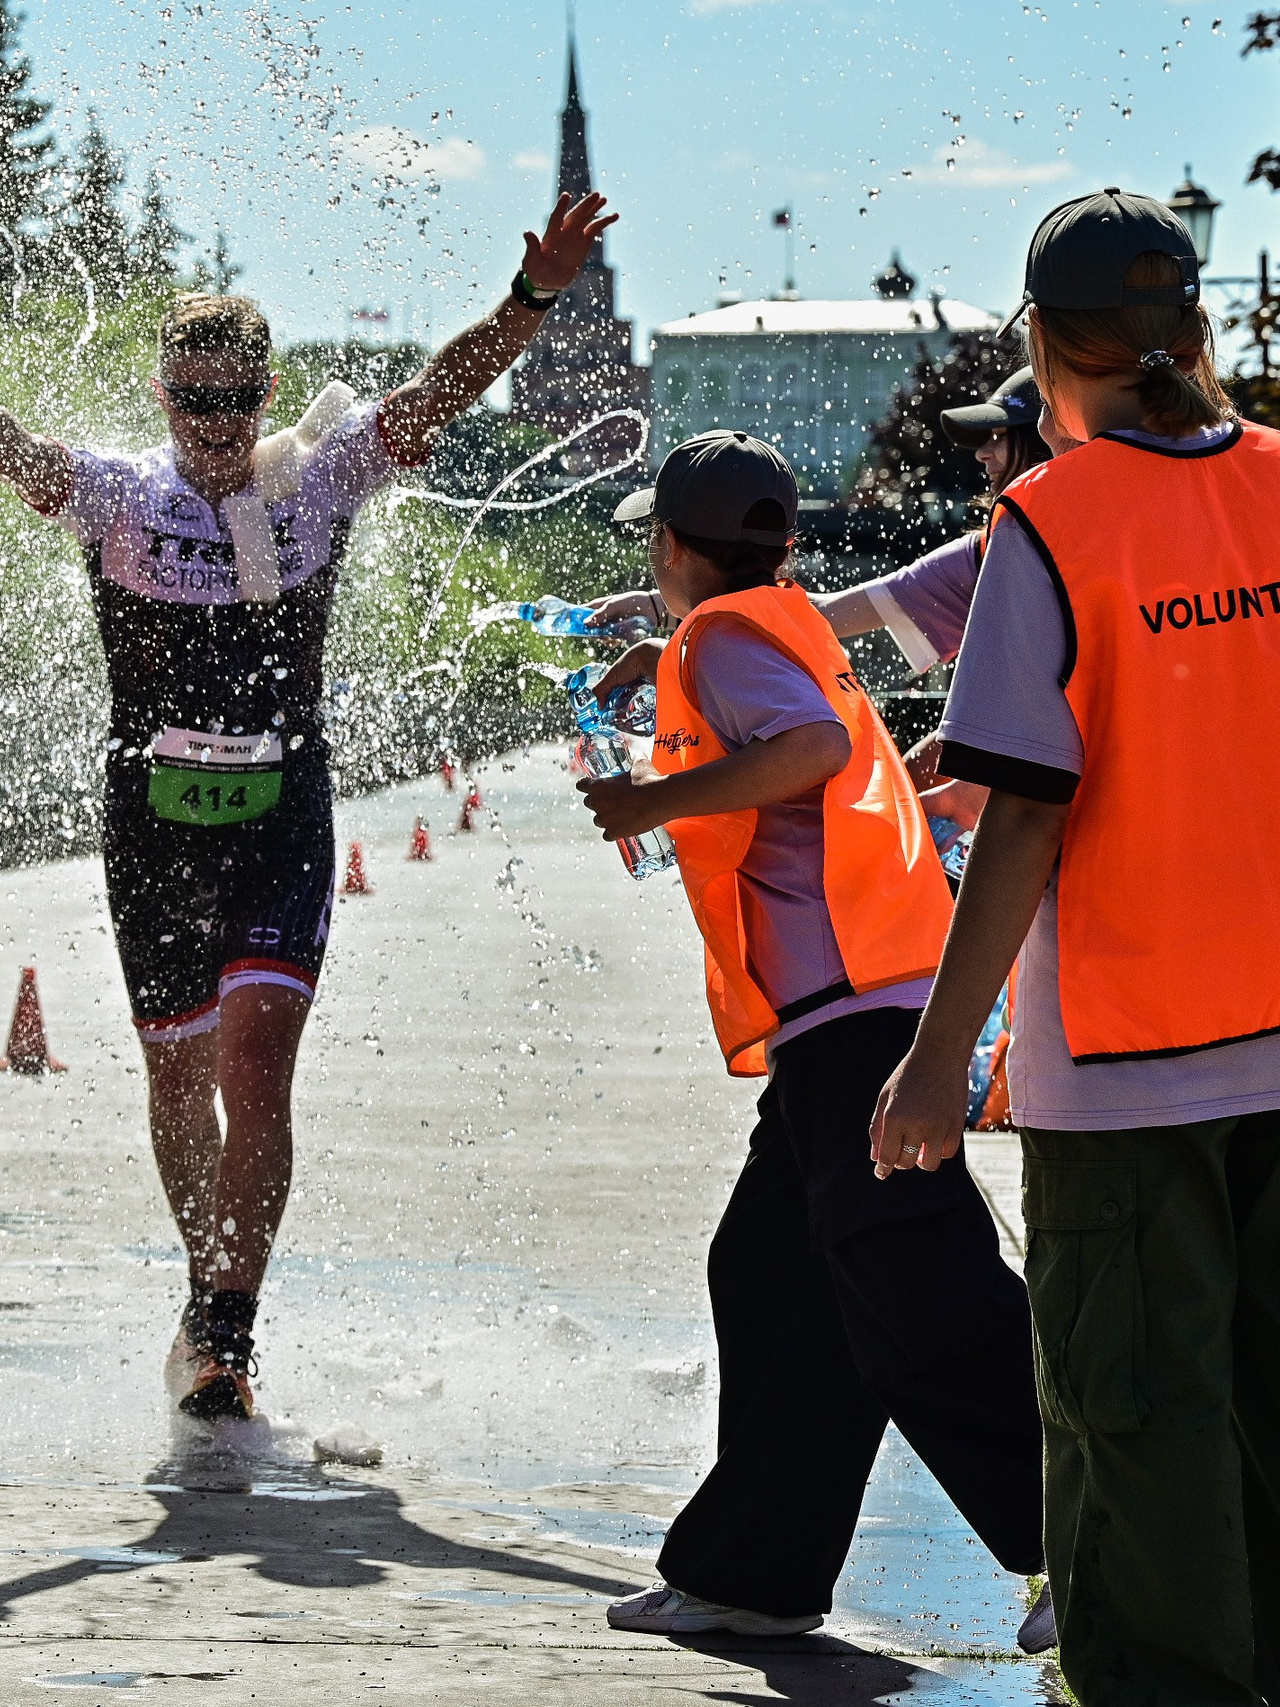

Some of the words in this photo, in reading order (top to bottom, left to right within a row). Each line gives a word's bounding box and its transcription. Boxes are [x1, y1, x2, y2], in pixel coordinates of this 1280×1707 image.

[1139, 581, 1280, 634] VOLUNT
[654, 728, 699, 755] Helpers
[180, 784, 247, 811] 414
